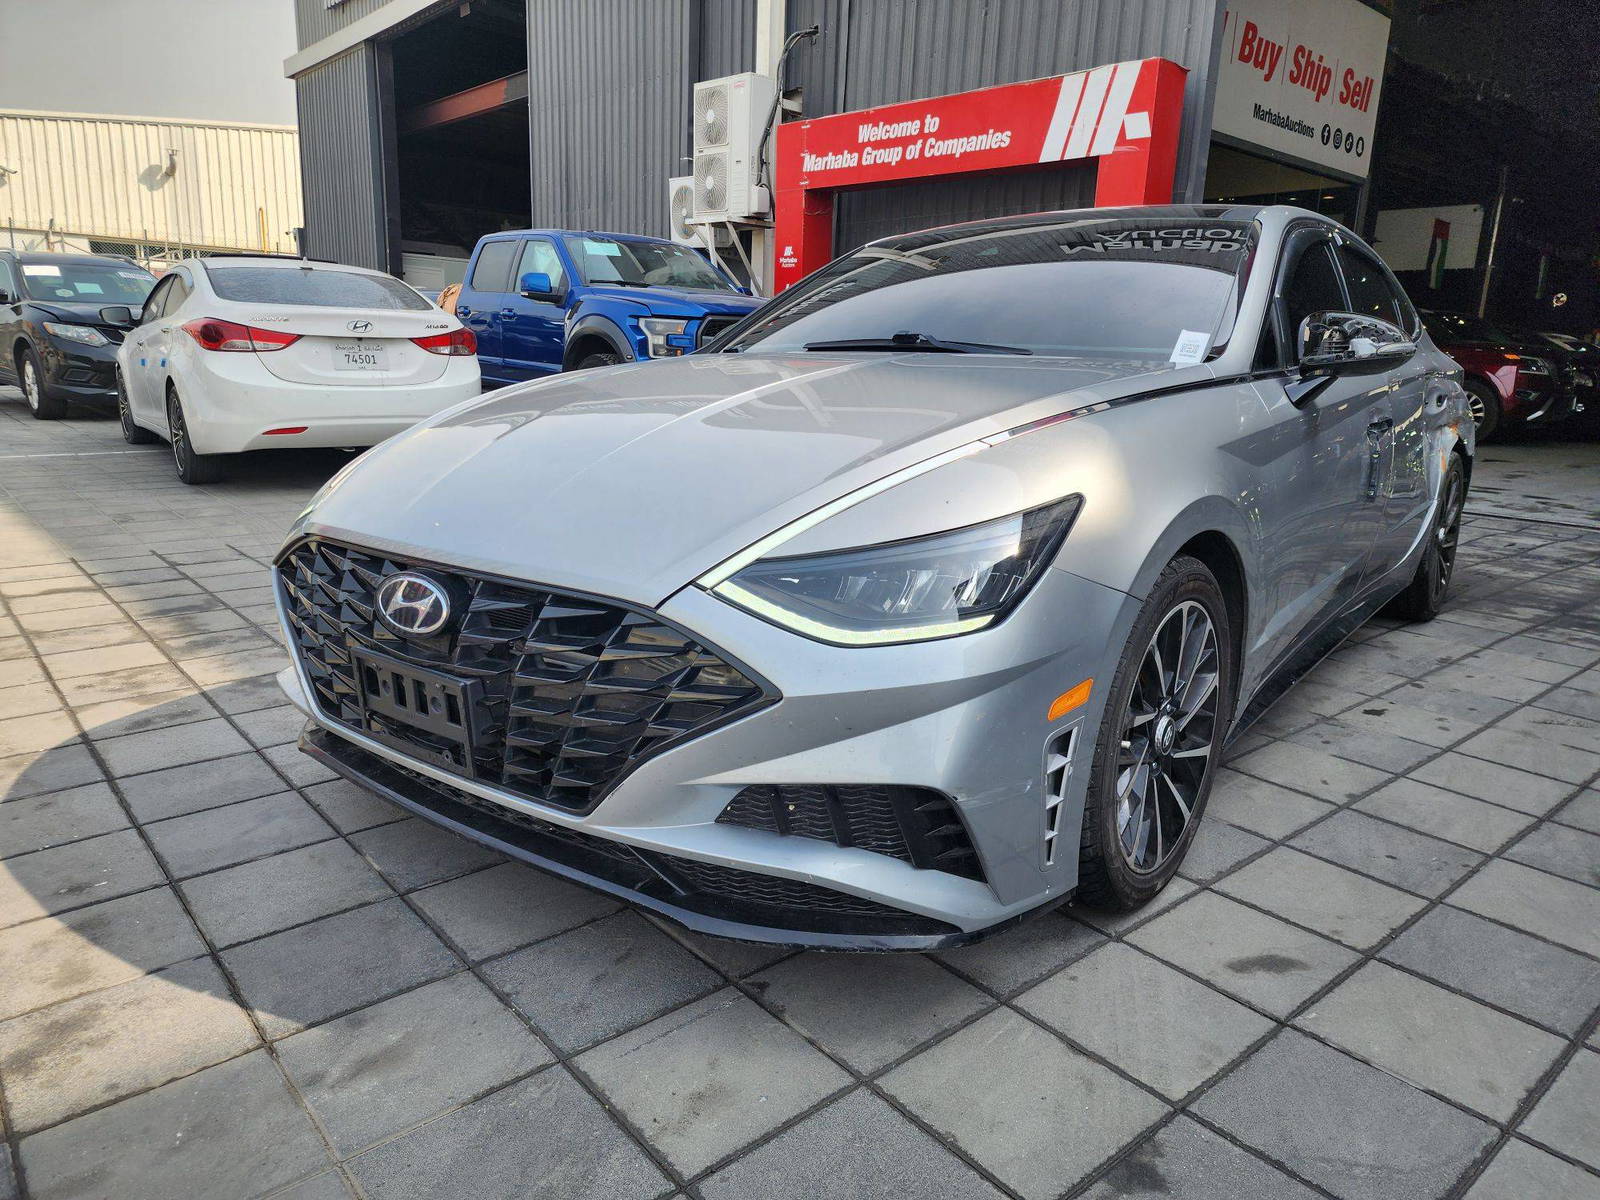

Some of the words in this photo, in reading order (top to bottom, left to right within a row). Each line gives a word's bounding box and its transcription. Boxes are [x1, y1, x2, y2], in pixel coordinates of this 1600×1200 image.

[1238, 21, 1283, 82] Buy
[1289, 45, 1332, 102] Ship
[1339, 68, 1375, 112] Sell
[858, 121, 920, 143] Welcome
[924, 114, 940, 133] to
[1253, 103, 1315, 138] MarhabaAuctions
[803, 150, 859, 172] Marhaba
[862, 146, 903, 166] Group
[905, 139, 923, 160] of
[925, 129, 1012, 157] Companies
[344, 353, 377, 365] 74501
